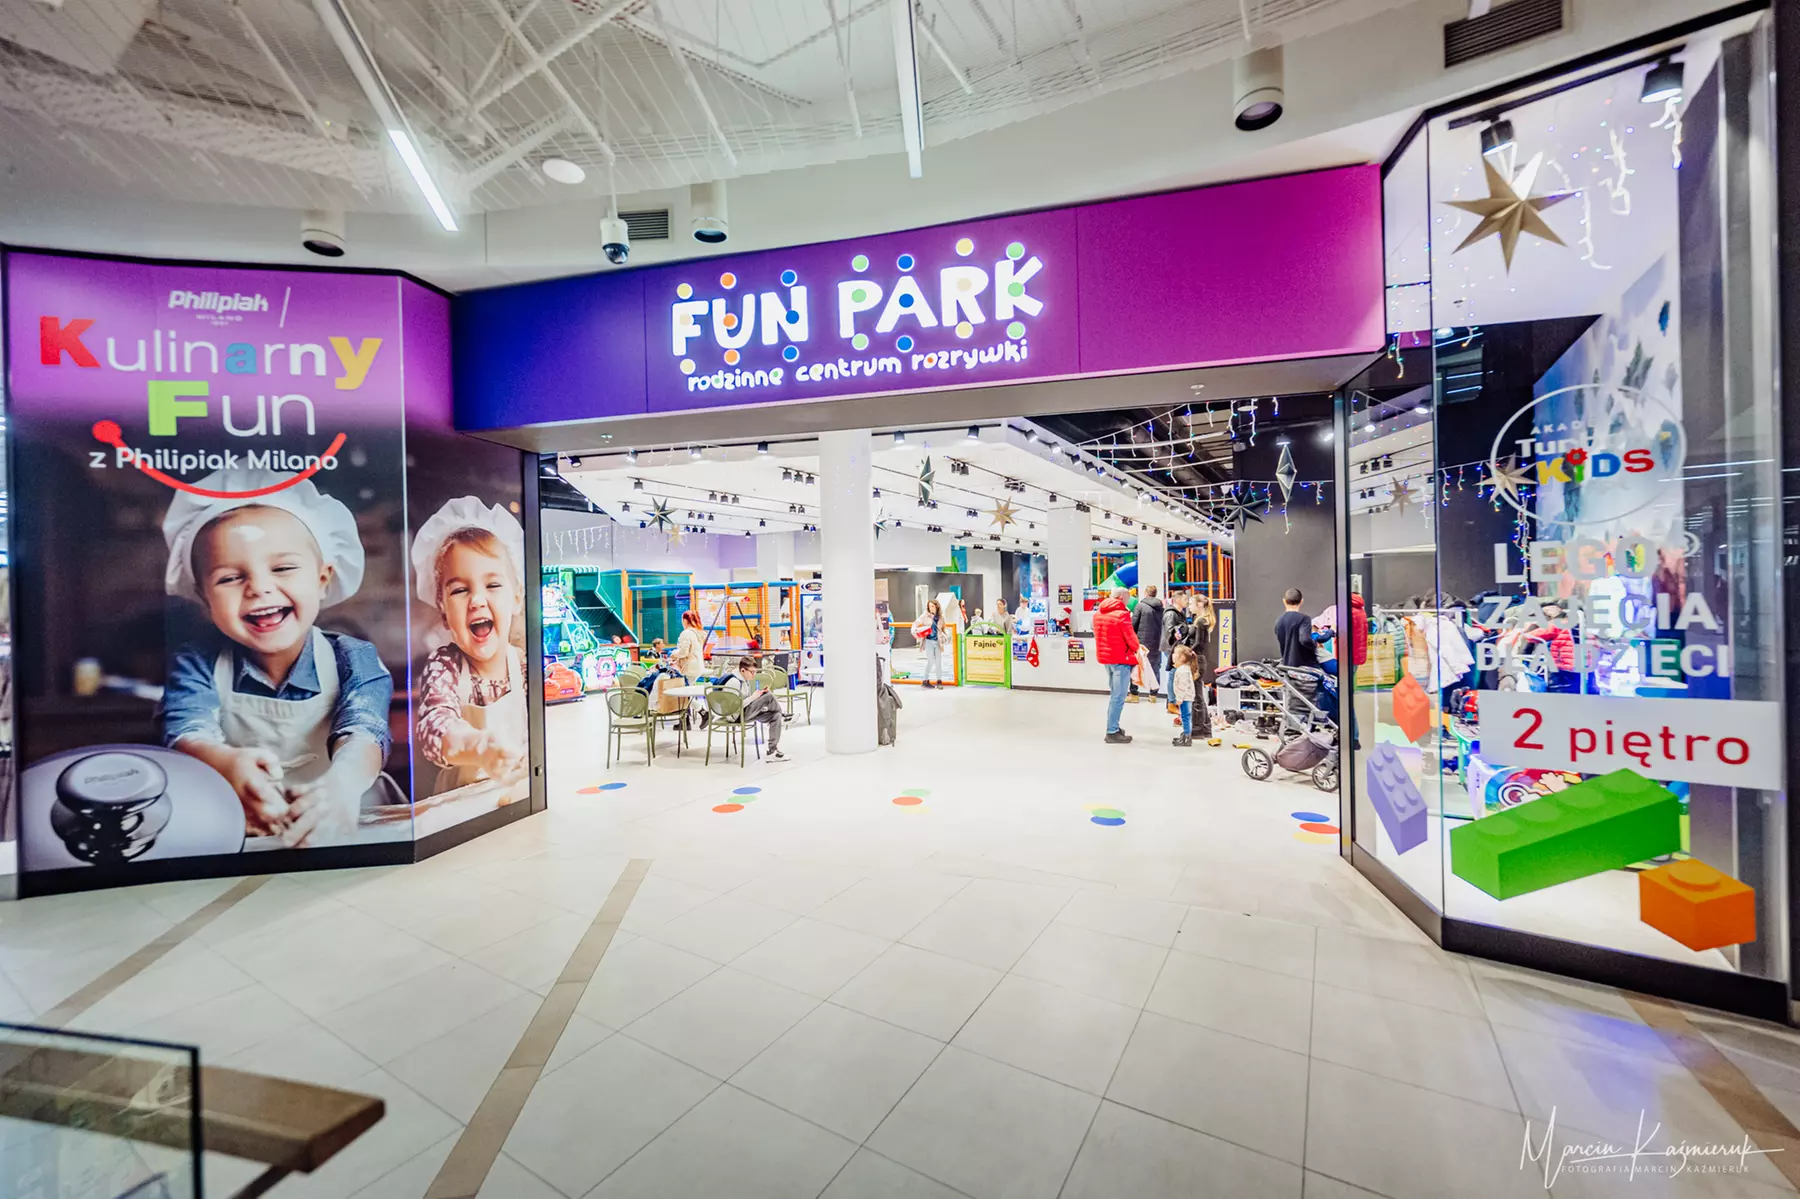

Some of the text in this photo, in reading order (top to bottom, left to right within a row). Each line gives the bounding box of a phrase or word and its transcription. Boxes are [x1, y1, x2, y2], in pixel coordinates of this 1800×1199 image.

[672, 256, 1044, 356] FUN PARK
[40, 316, 383, 391] Kulinarny
[687, 339, 1028, 392] rodzinne centrum rozrywki
[148, 380, 316, 438] Fun
[88, 447, 339, 475] z Philipiak Milano
[973, 640, 997, 649] Fajnie
[1476, 642, 1729, 678] DLA DZIECI
[1511, 707, 1750, 768] 2 piętro
